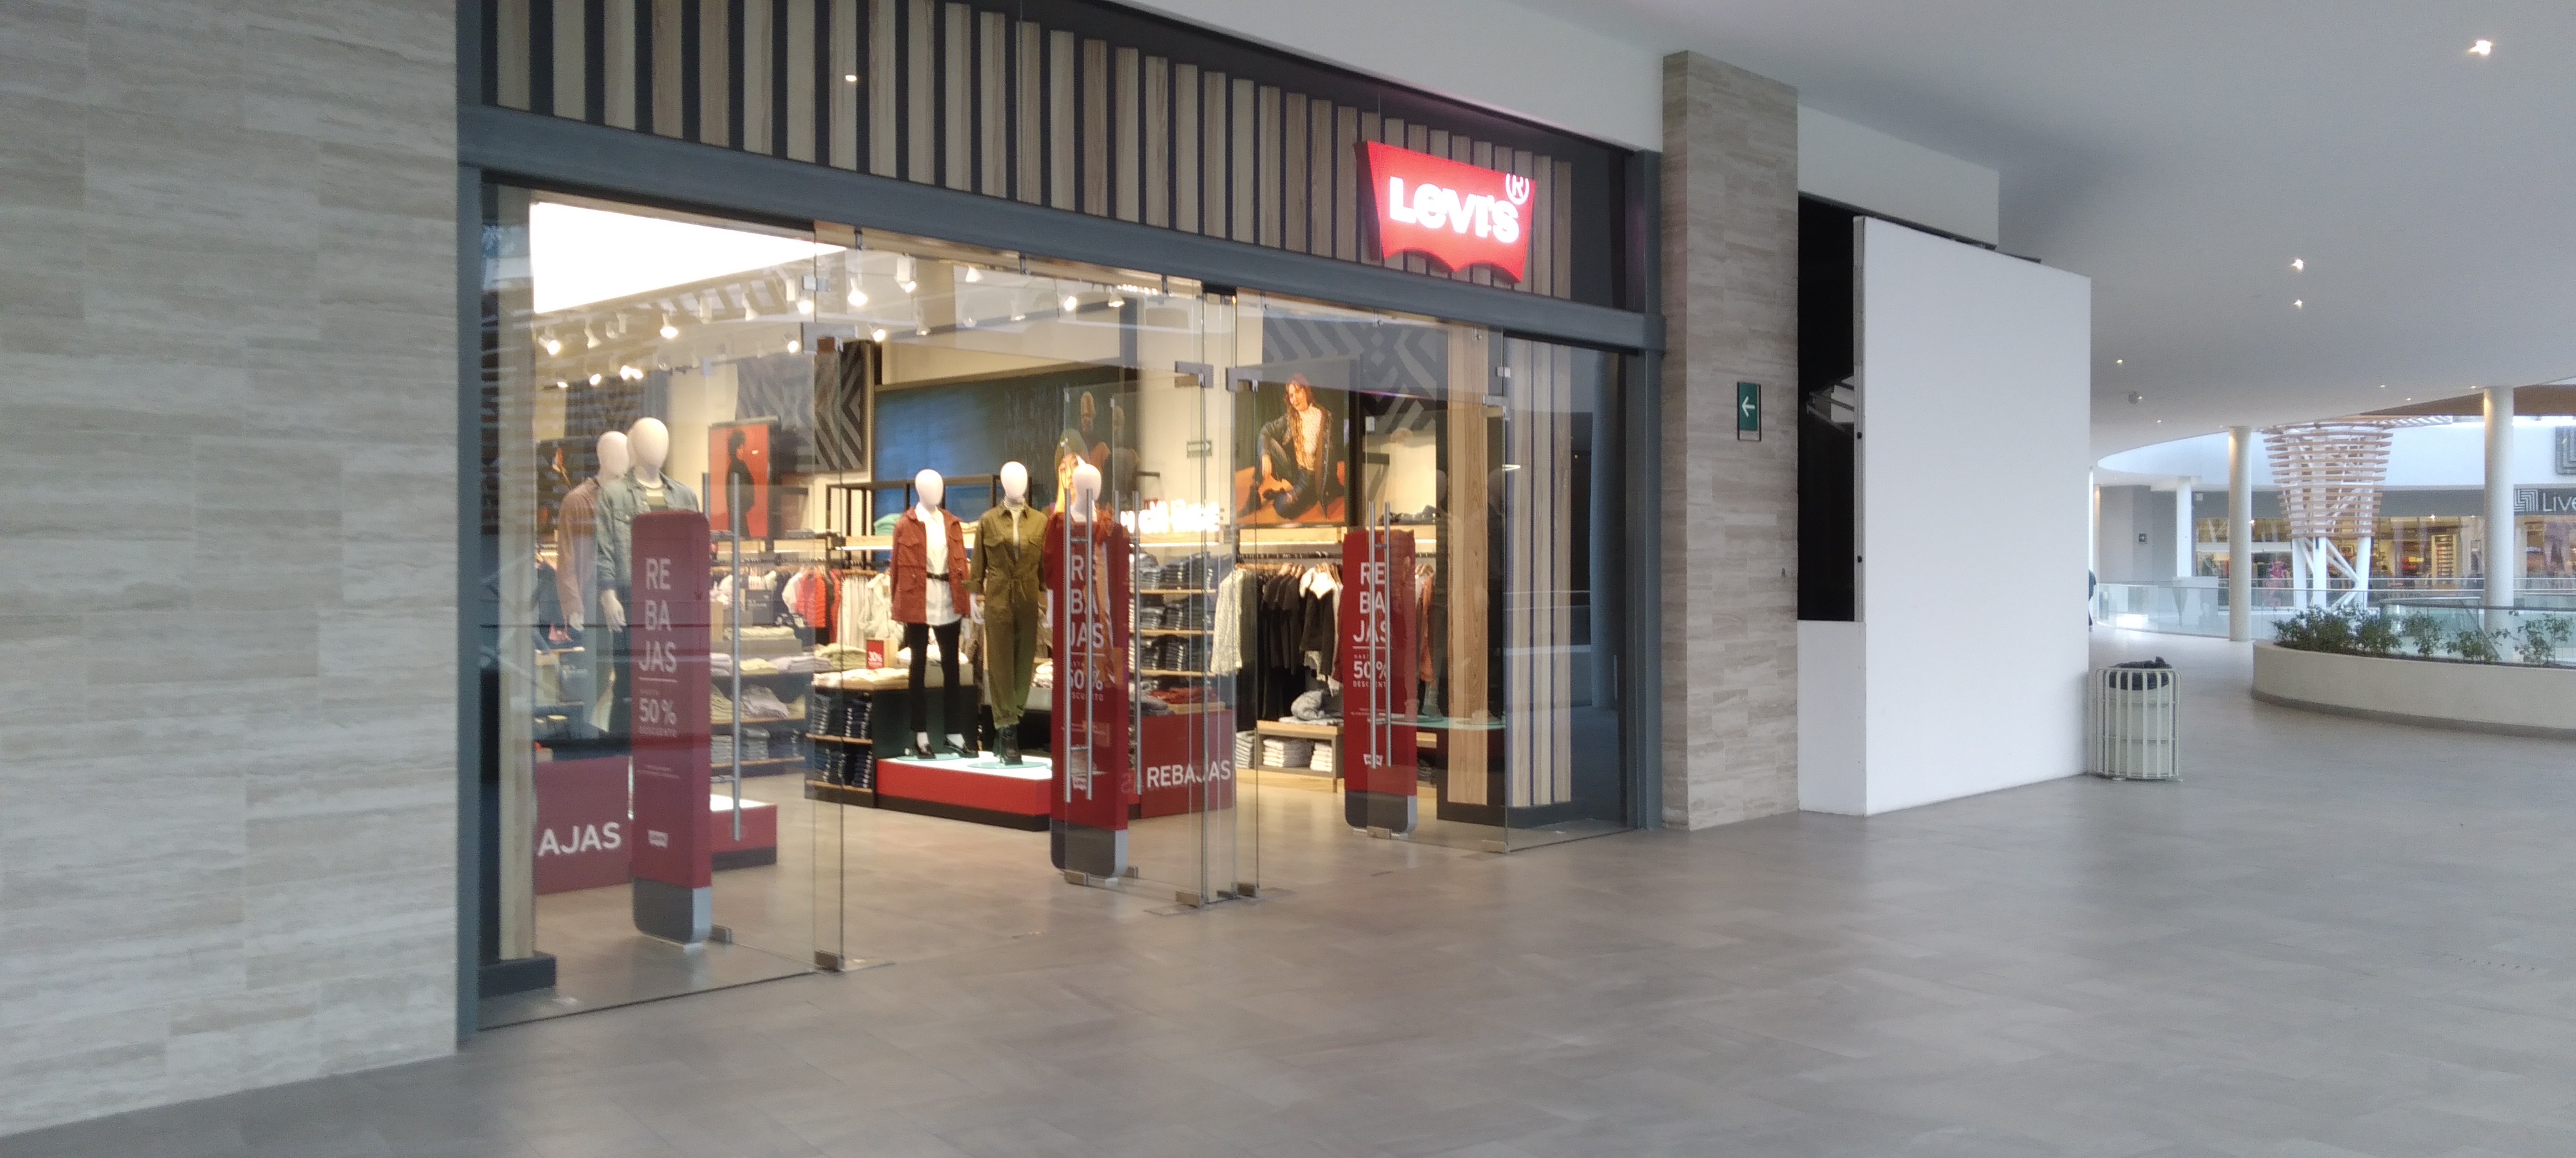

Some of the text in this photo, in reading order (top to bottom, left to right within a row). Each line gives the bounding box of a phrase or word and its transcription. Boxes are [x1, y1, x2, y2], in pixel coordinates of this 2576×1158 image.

[645, 557, 671, 590] RE
[645, 599, 671, 631] BA
[638, 640, 676, 673] JAS
[639, 697, 677, 725] 50%
